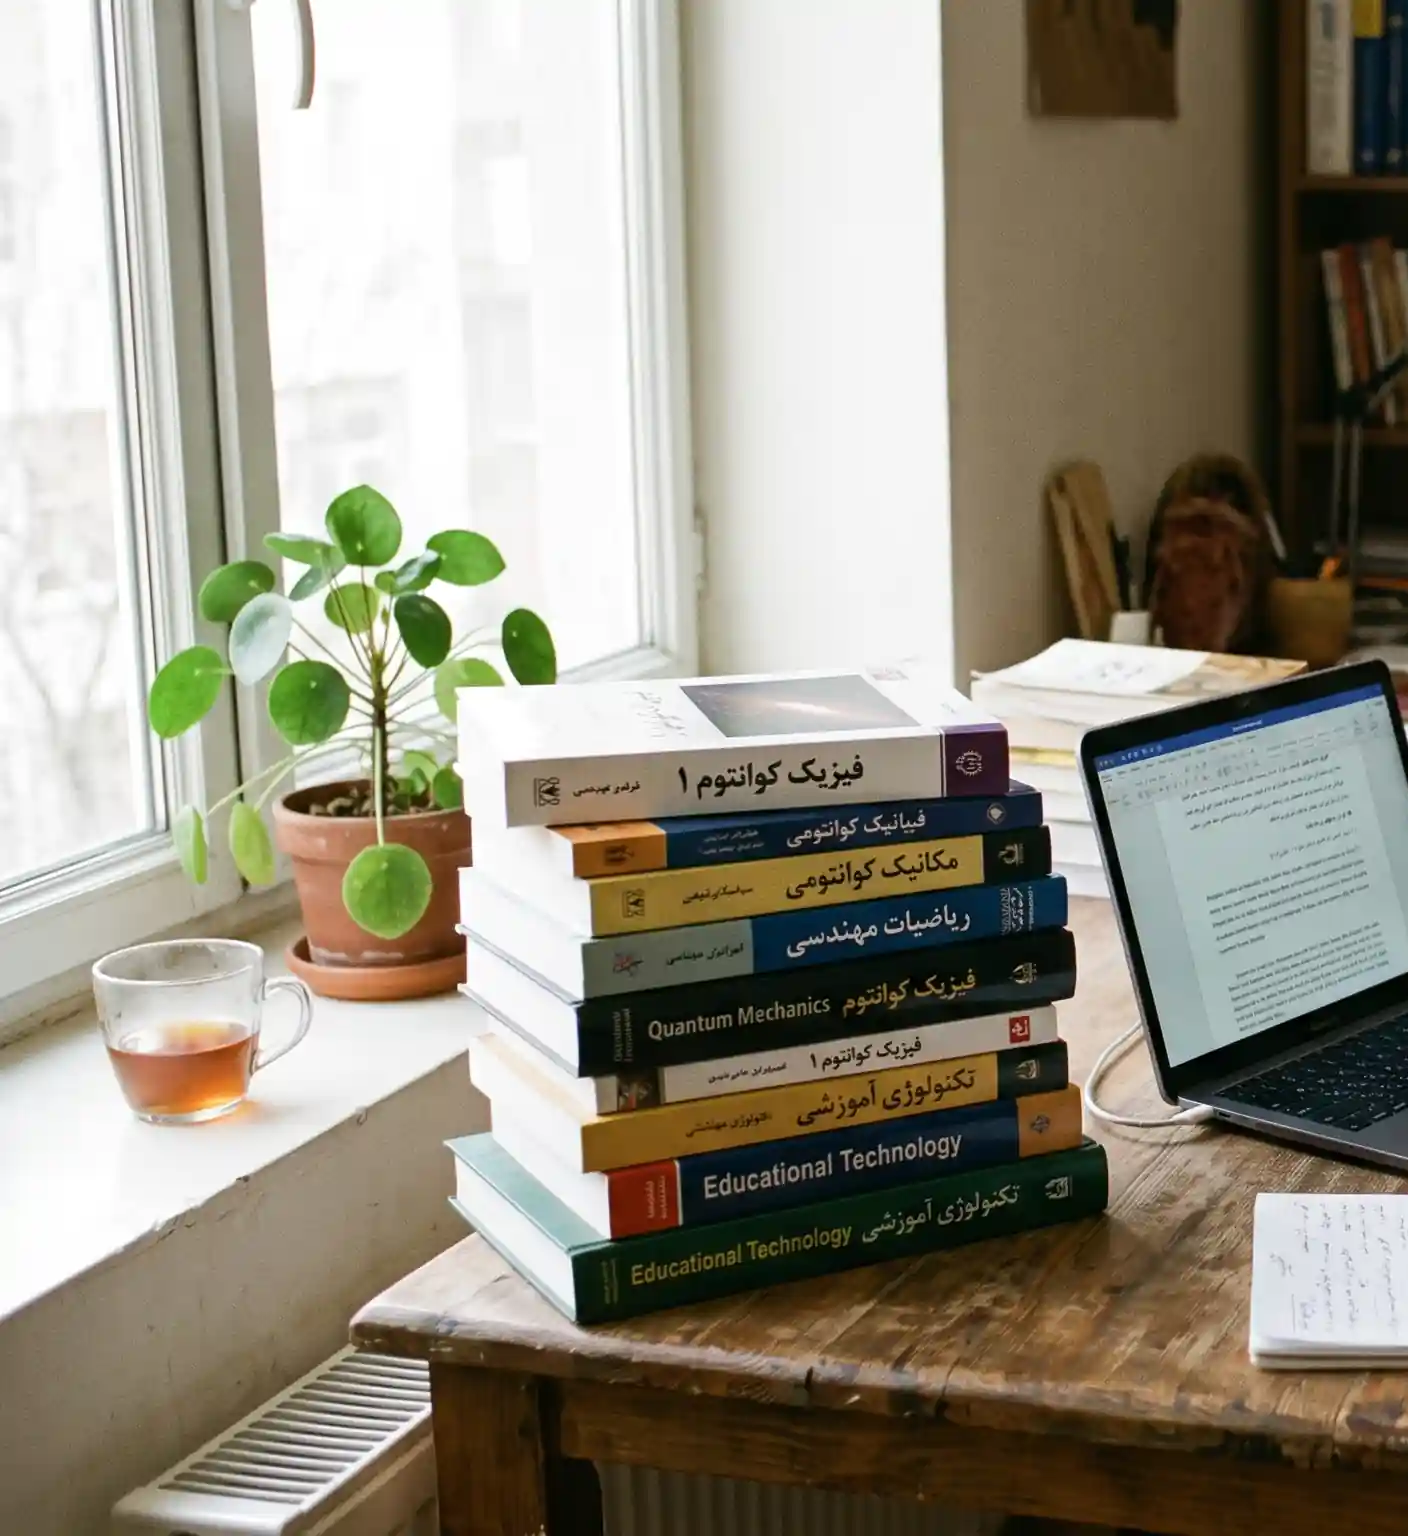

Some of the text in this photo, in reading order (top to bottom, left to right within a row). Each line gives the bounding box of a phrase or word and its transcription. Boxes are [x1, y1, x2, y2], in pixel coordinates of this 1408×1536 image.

[697, 760, 782, 800] کوانتوم
[787, 754, 864, 790] فیزیک
[786, 817, 860, 849] کوانتومی
[786, 858, 876, 900] کوانتومی
[881, 849, 959, 882] مکانیک
[786, 920, 878, 958] مهندسی
[883, 904, 971, 938] ریاضیات
[843, 968, 977, 1019] فیزیک کوانتوم
[647, 1013, 733, 1041] Quantum
[737, 996, 831, 1026] Mechanics
[822, 1044, 873, 1072] کوانتوم
[876, 1036, 922, 1060] فیزیک
[796, 1068, 976, 1127] تکنولوژی آموزشی
[704, 1153, 833, 1199] Educational
[839, 1134, 962, 1172] Technology
[862, 1184, 1020, 1243] تکنولوژی آموزشی
[631, 1243, 742, 1286] Educational
[747, 1226, 852, 1260] Technology
